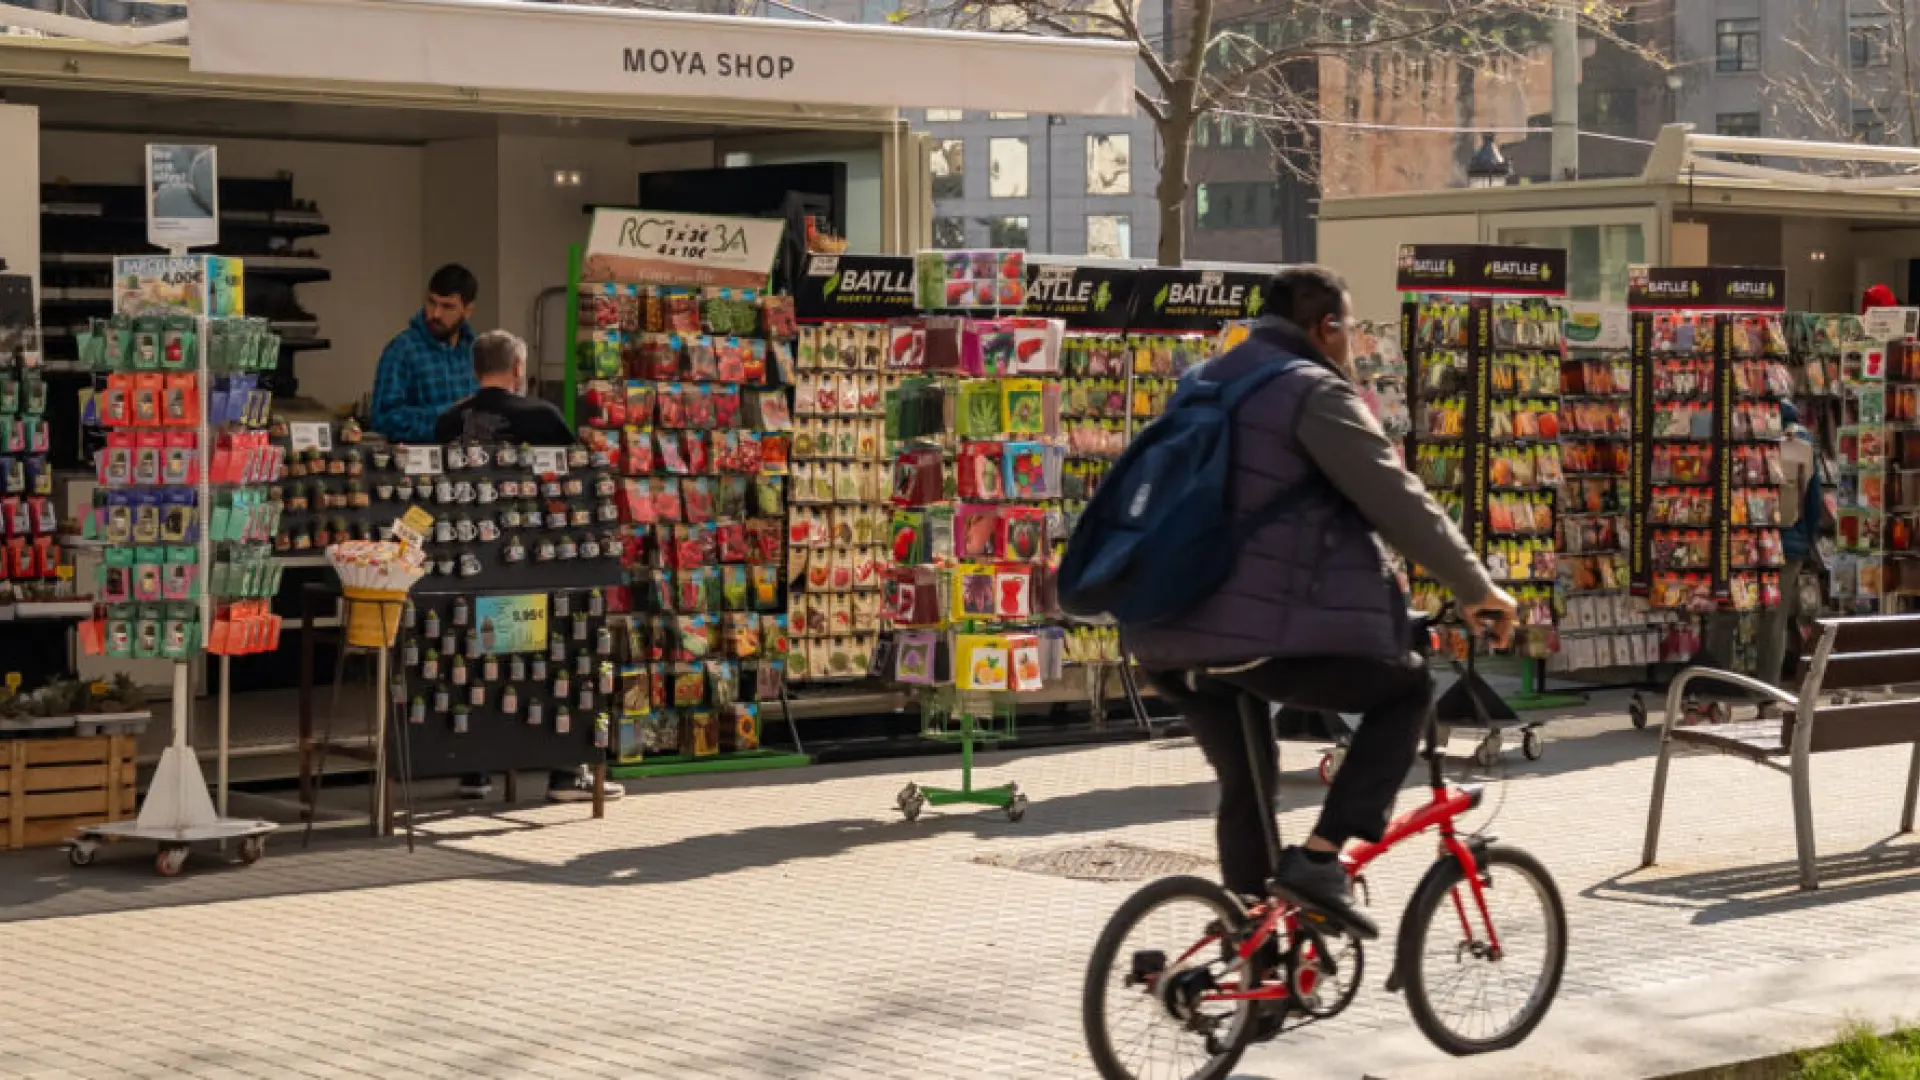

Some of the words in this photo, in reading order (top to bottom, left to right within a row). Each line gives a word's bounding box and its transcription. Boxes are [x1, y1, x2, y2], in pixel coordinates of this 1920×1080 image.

[623, 47, 706, 76] MOYA
[717, 52, 794, 79] SHOP
[1493, 261, 1540, 275] BATLLE
[840, 269, 914, 292] BATLL
[1026, 280, 1093, 301] ATLLE
[1168, 282, 1245, 306] BATLLE
